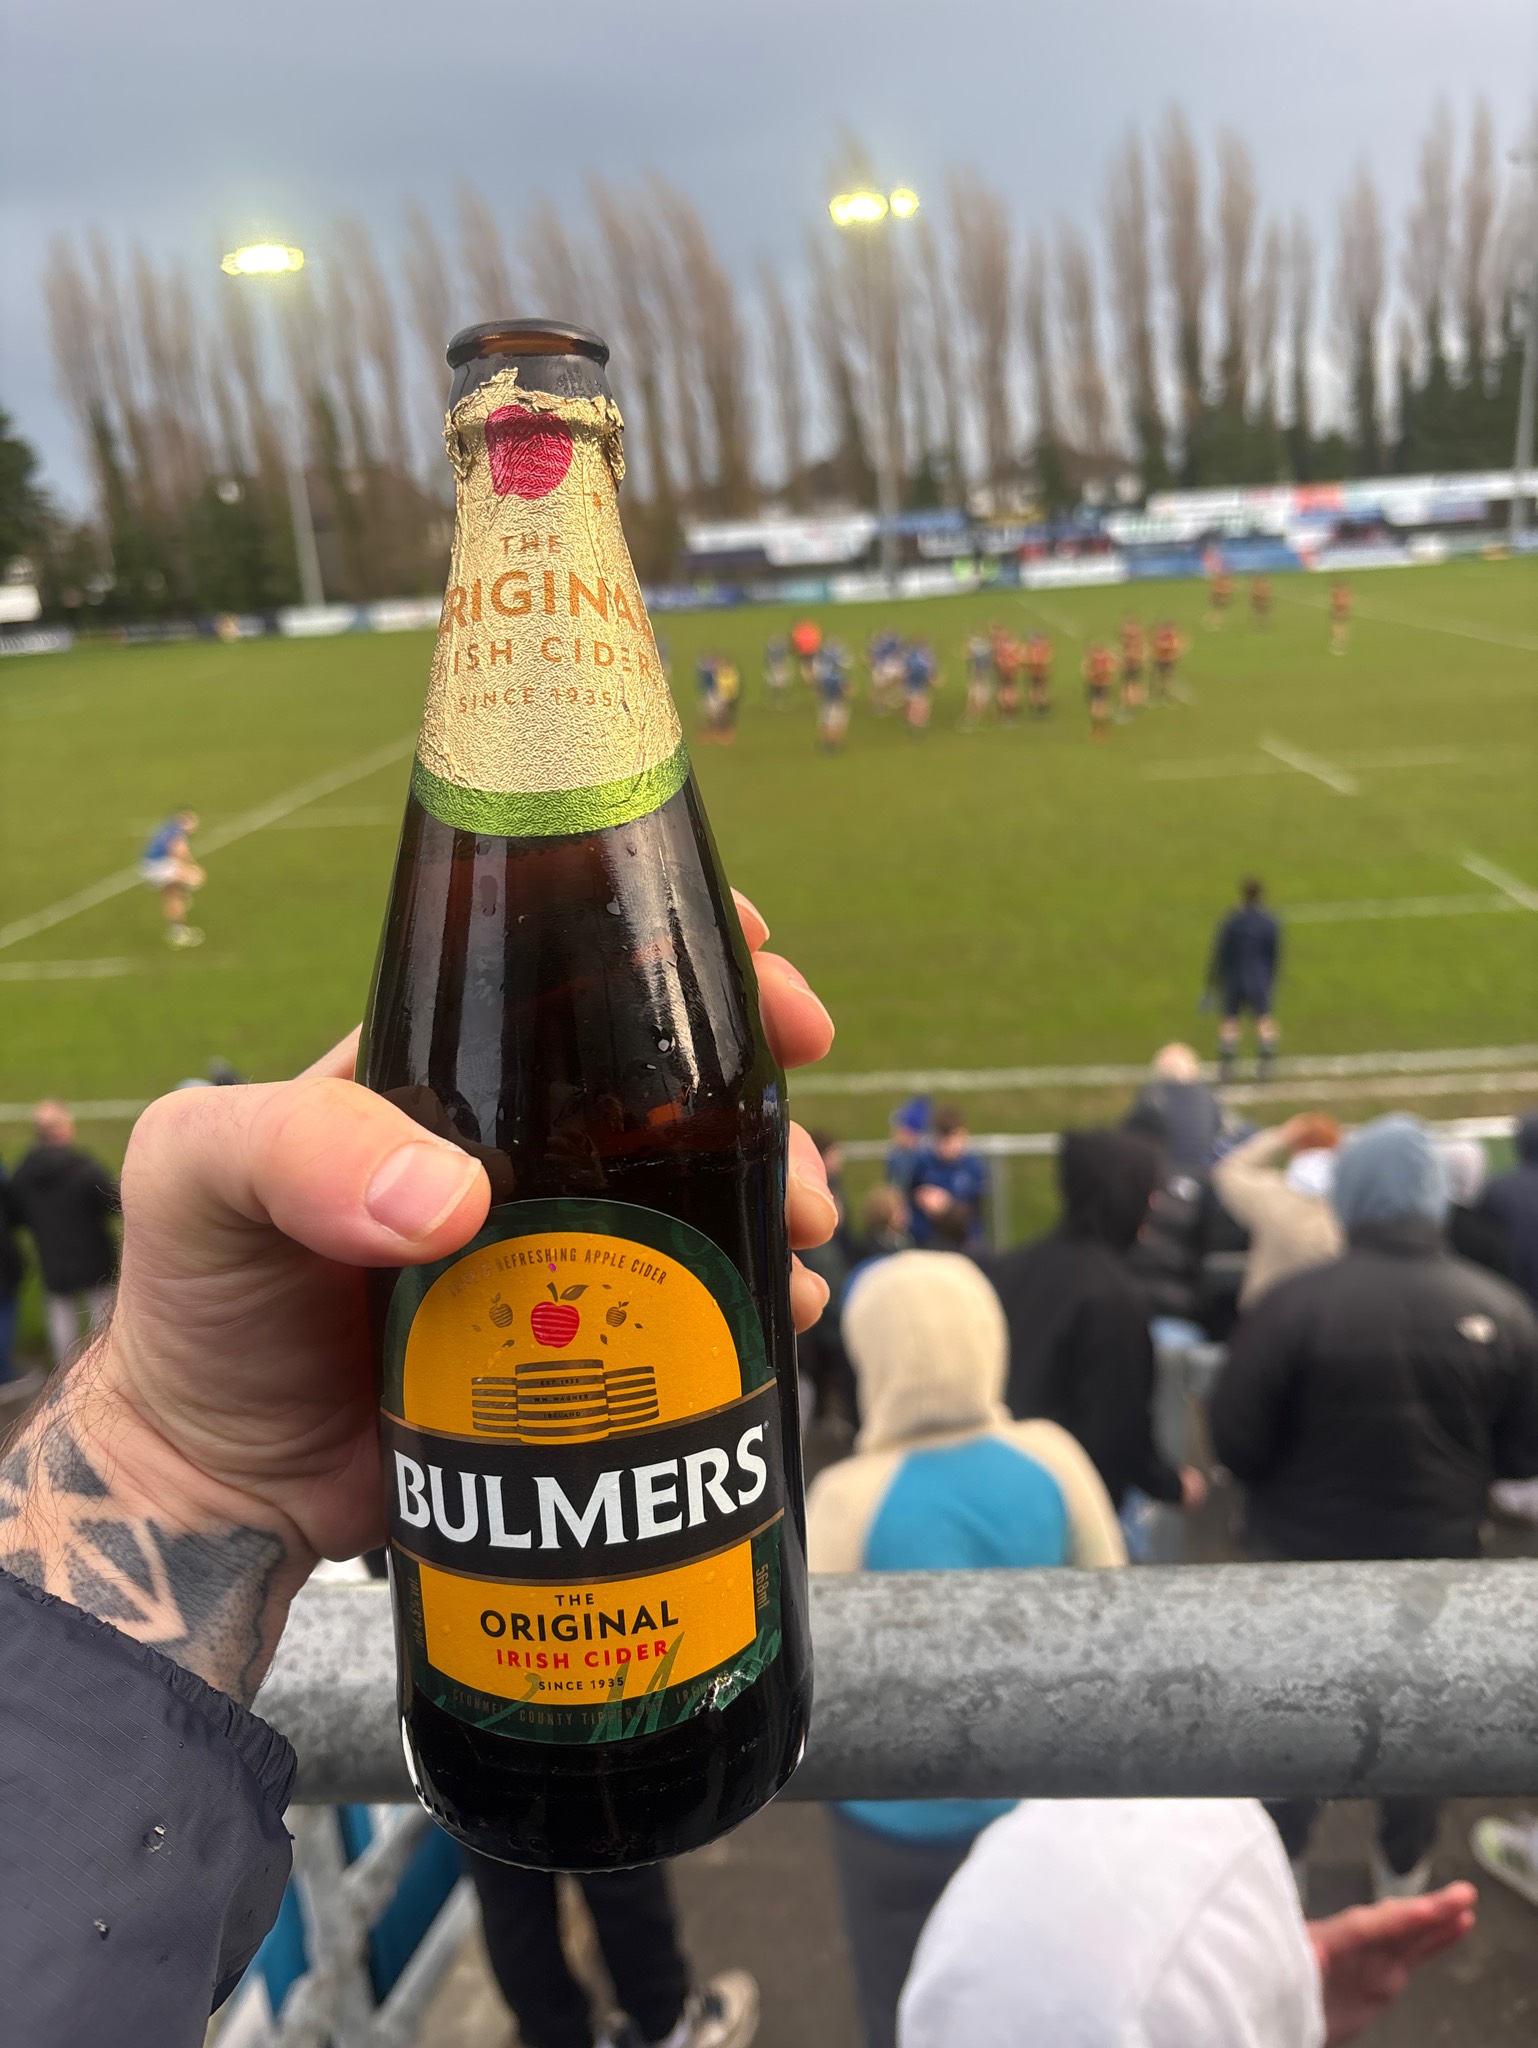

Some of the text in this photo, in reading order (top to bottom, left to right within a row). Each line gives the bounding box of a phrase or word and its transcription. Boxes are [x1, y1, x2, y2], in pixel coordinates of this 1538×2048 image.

[501, 532, 562, 555] THE
[438, 569, 652, 641] RIGINAL
[437, 636, 652, 680] ISH CIDER
[459, 687, 612, 714] SINCE 1935
[496, 1248, 577, 1272] REFRESHING
[585, 1250, 626, 1269] APPLE
[631, 1259, 667, 1285] CIDER
[543, 1411, 581, 1419] IRELAND
[393, 1423, 768, 1549] BULMERS
[555, 1593, 594, 1606] THE
[755, 1563, 770, 1610] 568ml
[480, 1600, 679, 1642] ORIGINAL
[497, 1640, 667, 1669] IRISH CIDER
[538, 1677, 624, 1691] SINCE 1935
[519, 1709, 573, 1726] COUNTY
